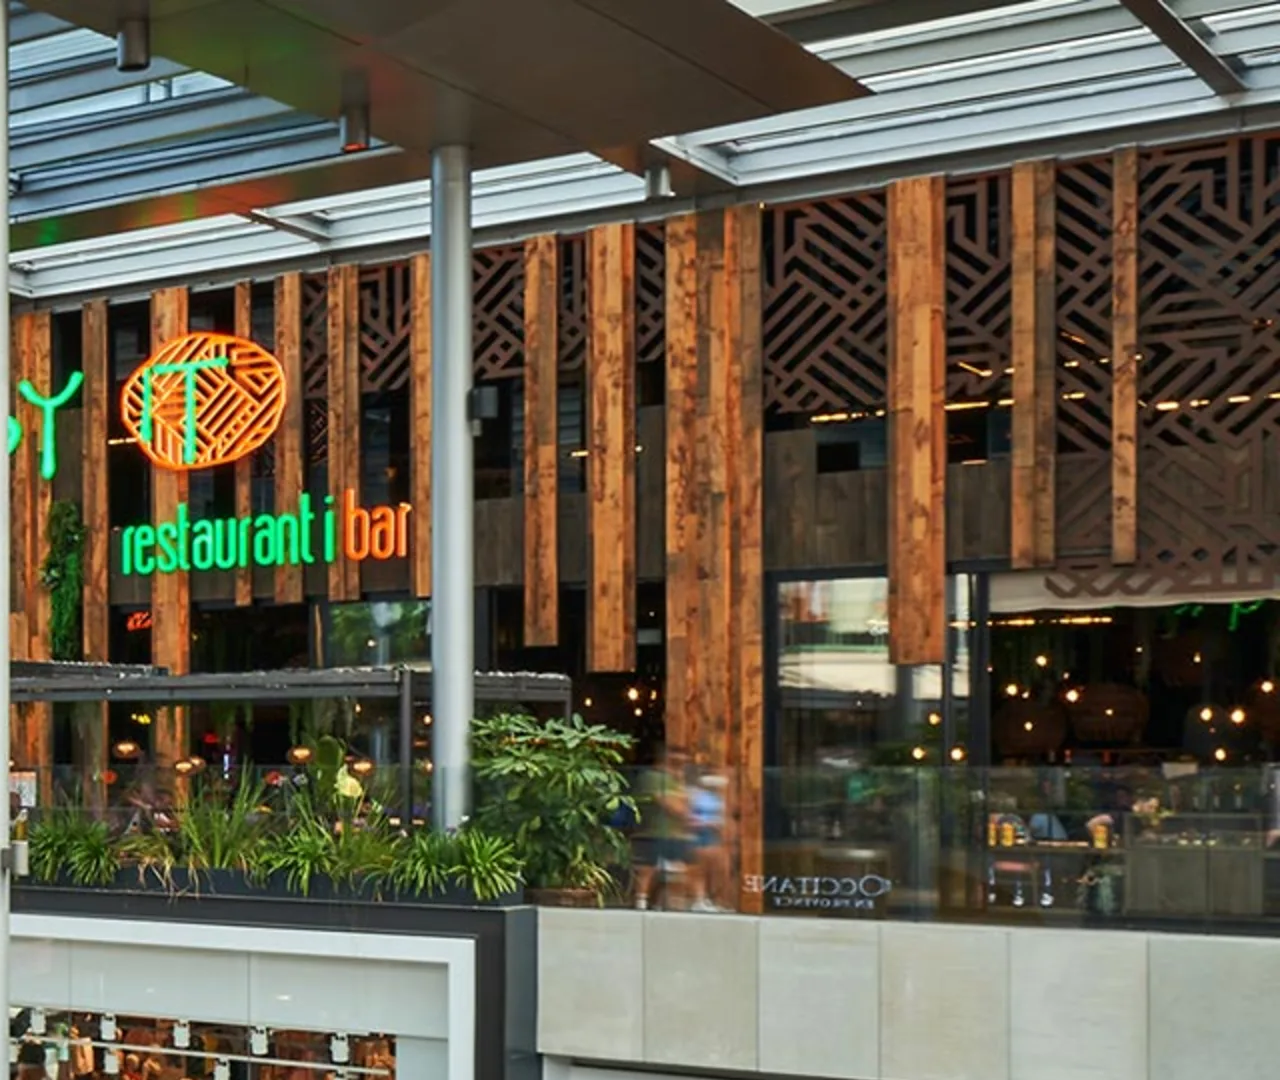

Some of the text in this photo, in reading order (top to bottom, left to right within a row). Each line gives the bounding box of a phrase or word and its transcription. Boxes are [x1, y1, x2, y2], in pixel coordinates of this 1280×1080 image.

[122, 488, 412, 576] restaurant i bar
